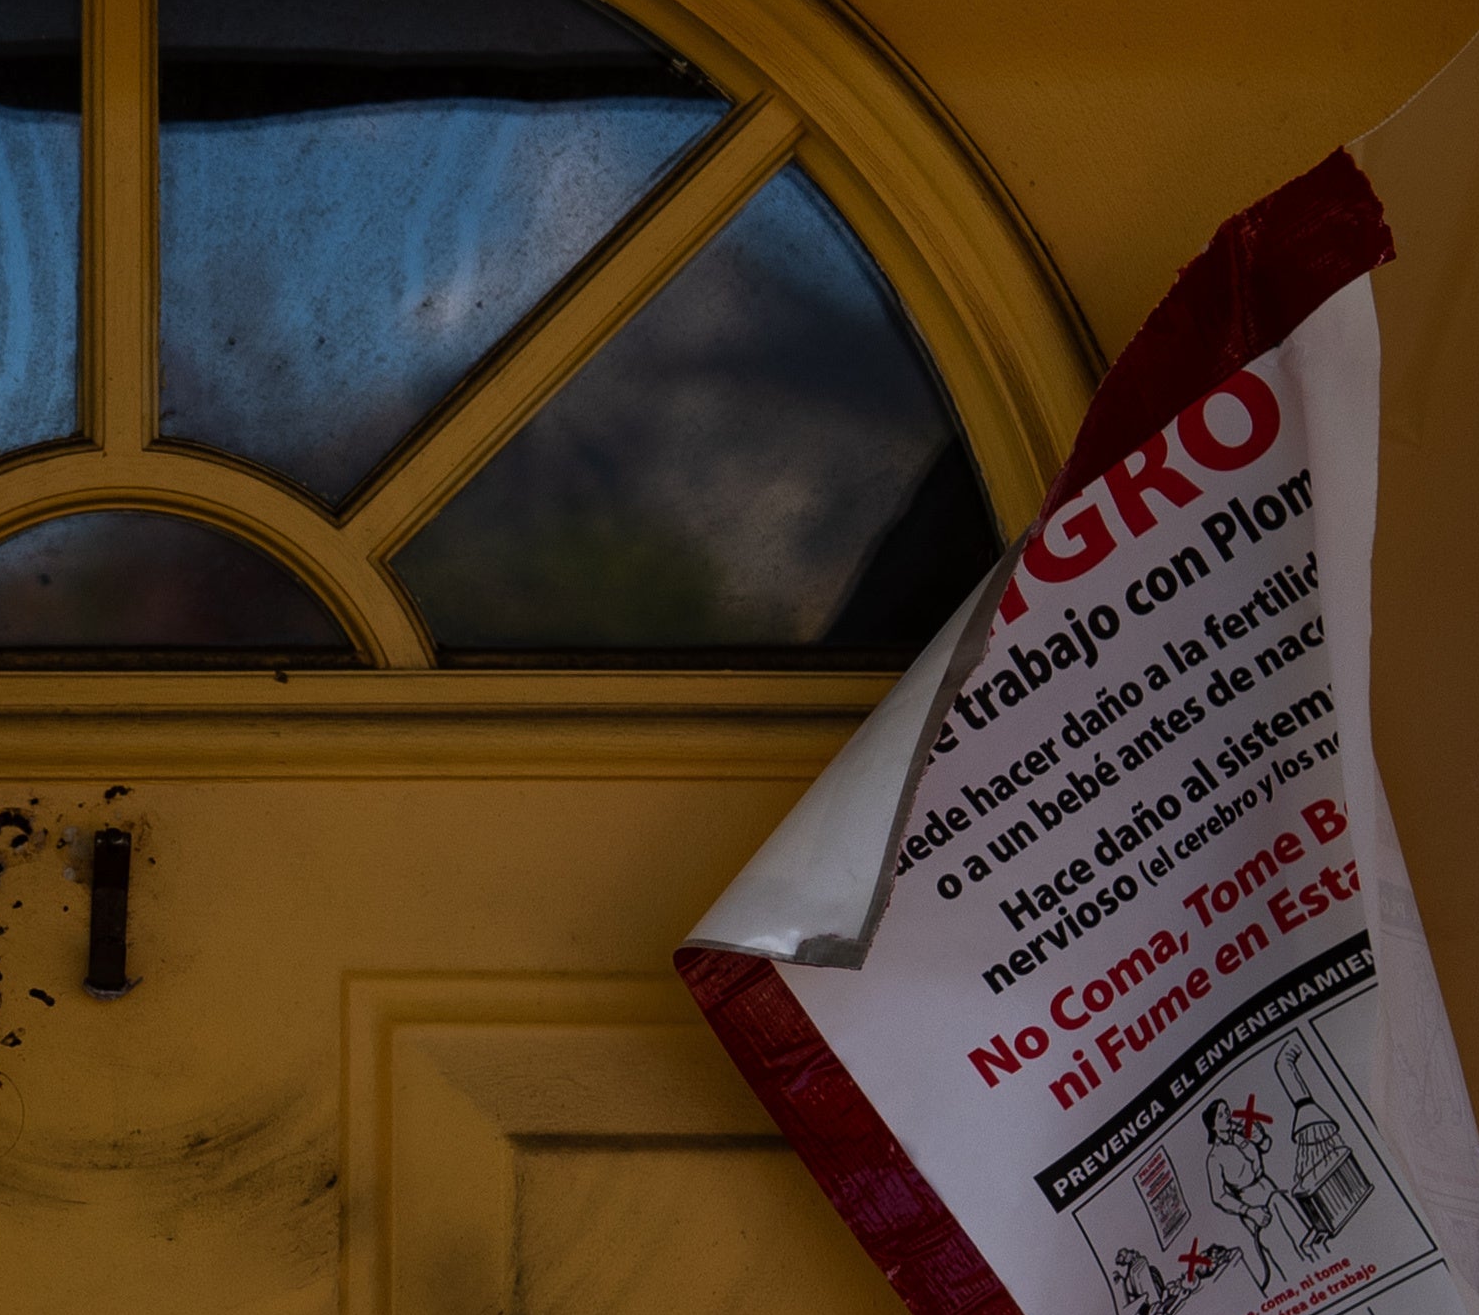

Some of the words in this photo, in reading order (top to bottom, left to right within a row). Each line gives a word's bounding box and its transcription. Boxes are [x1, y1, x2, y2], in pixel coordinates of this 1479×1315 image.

[952, 604, 1120, 730] trabajo
[1124, 546, 1211, 615] con
[959, 737, 1061, 817] hacer
[1060, 681, 1143, 749] daño
[1142, 663, 1171, 691] a
[1162, 639, 1209, 675] la
[936, 873, 962, 900] o
[962, 854, 992, 882] a
[986, 820, 1038, 863] un
[1026, 751, 1120, 831] bebé
[1116, 696, 1206, 771] antes
[1205, 666, 1256, 707] de
[981, 874, 1138, 994] nervioso
[1137, 844, 1175, 887] (el
[1173, 788, 1258, 859] cerebro
[1256, 773, 1273, 803] y
[1270, 749, 1314, 785] los
[998, 858, 1095, 932] Hace
[1093, 793, 1181, 866] daño
[1180, 757, 1220, 803] al
[1215, 683, 1334, 779] sistem
[967, 1025, 1049, 1087] No
[1049, 929, 1189, 1030] Coma,
[1182, 831, 1305, 928] Tome
[1048, 1049, 1101, 1110] ni
[1094, 967, 1212, 1072] Fume
[1214, 922, 1269, 975] en
[1051, 1098, 1165, 1199] PREVENGA
[1168, 1072, 1195, 1099] EL
